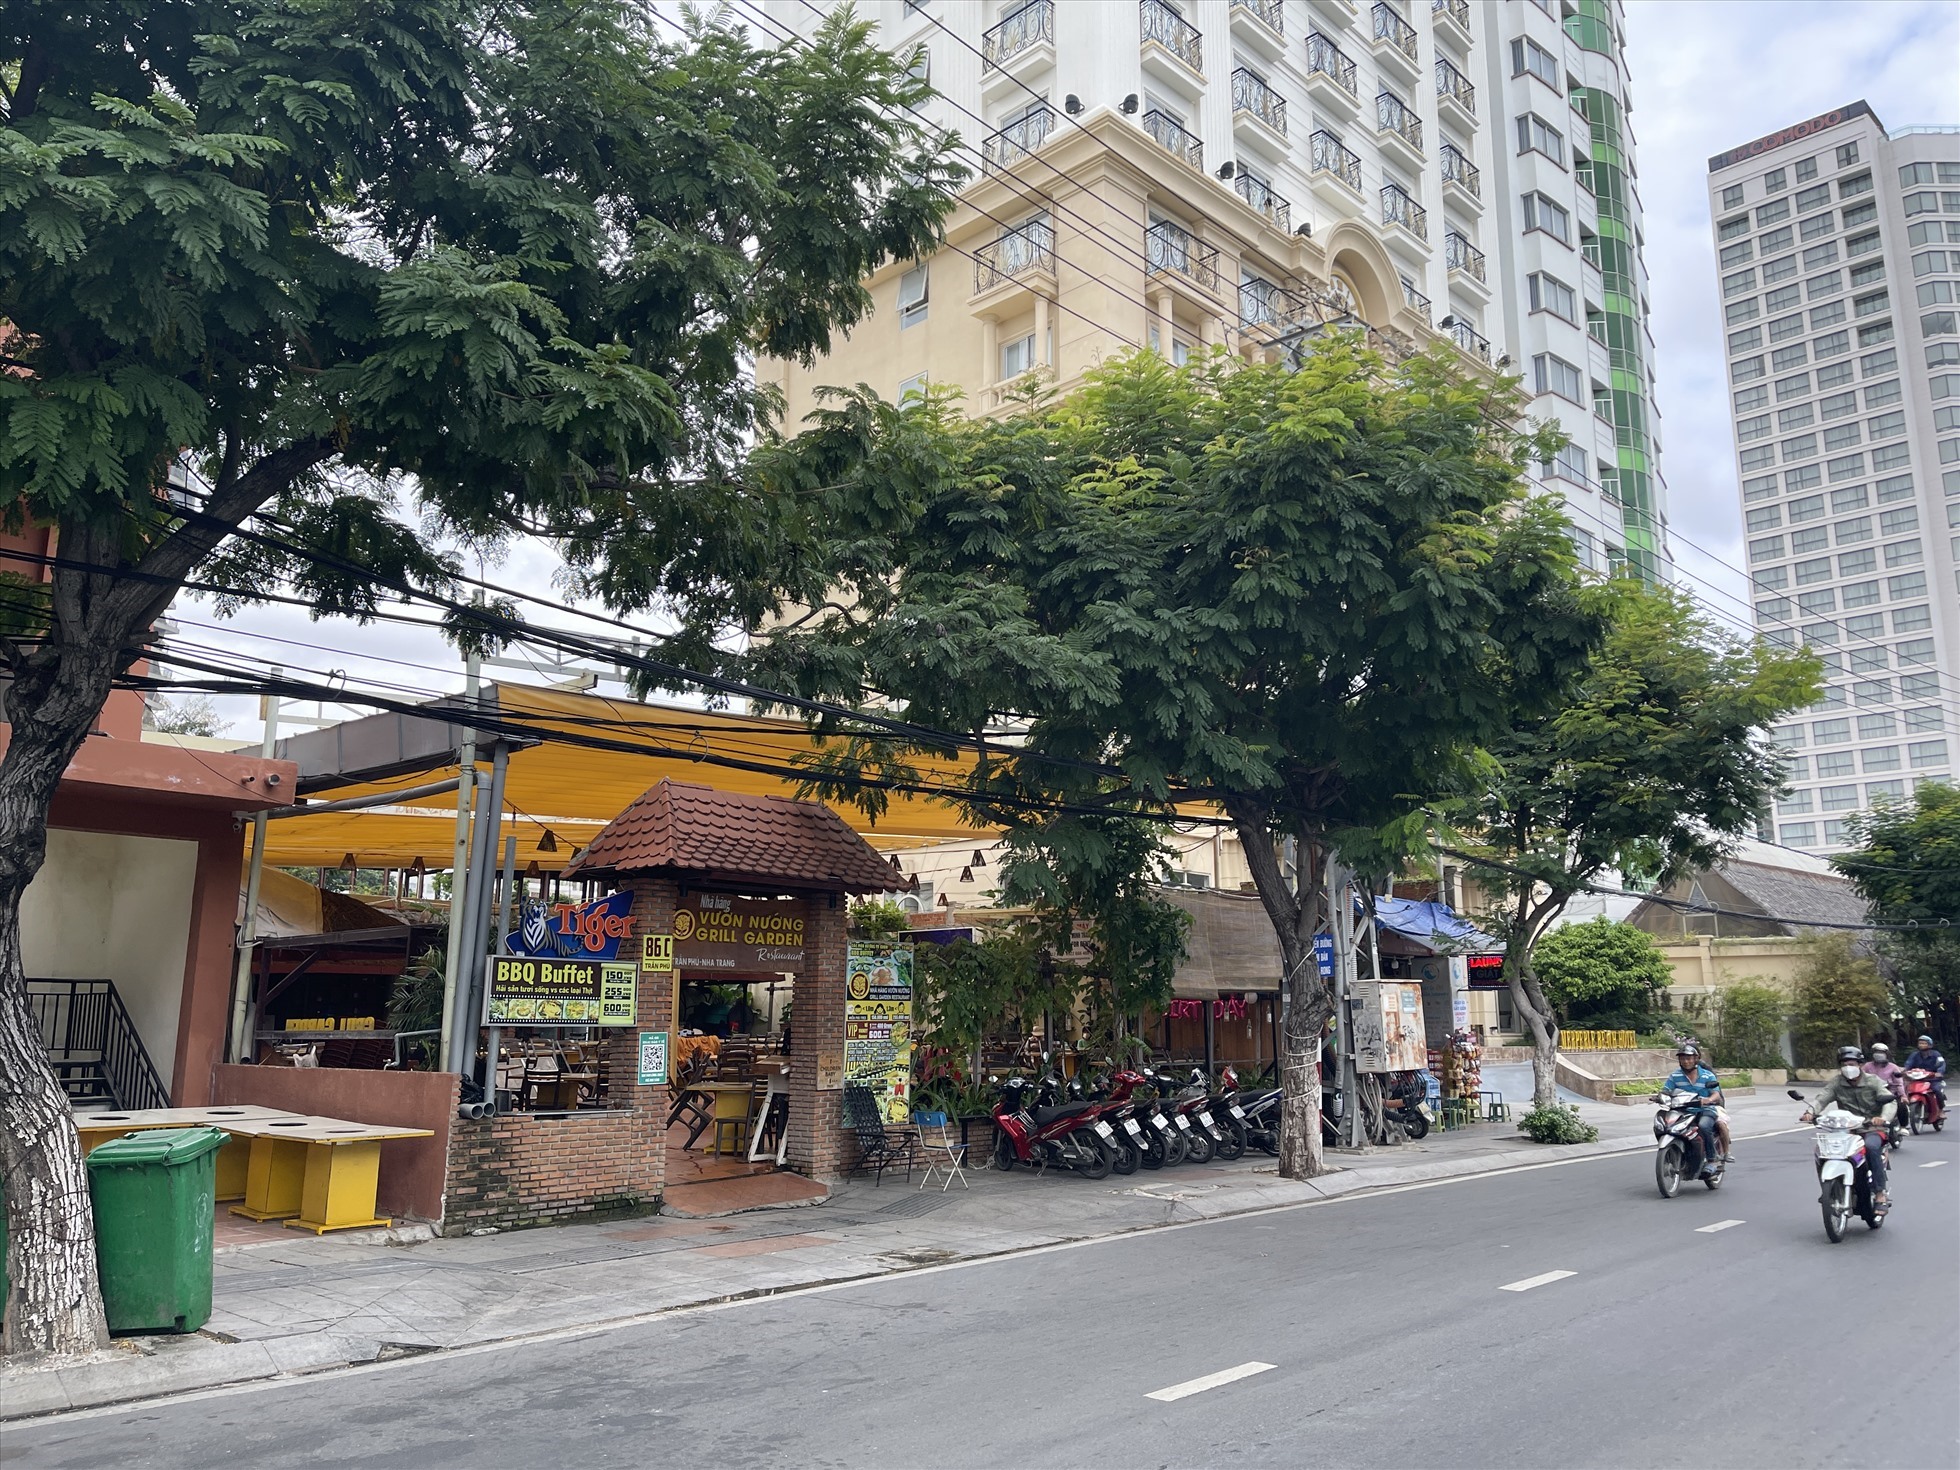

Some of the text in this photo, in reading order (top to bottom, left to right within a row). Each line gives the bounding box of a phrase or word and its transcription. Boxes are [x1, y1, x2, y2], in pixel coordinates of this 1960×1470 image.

[1749, 111, 1841, 155] COMODO
[553, 902, 637, 952] Tiger
[749, 912, 804, 931] NƯỚNG
[696, 928, 803, 946] GRILL GARDEN
[646, 937, 661, 957] 86
[756, 947, 805, 961] Restaurant
[645, 961, 658, 969] TRẦN
[716, 959, 735, 967] TRANG
[497, 961, 593, 985] BBQ Buffet
[606, 971, 622, 979] 150
[535, 986, 549, 994] sống
[571, 987, 581, 995] loại
[582, 987, 593, 995] Thịt
[605, 987, 622, 995] 255
[604, 1003, 621, 1011] 600
[848, 1024, 858, 1037] VIP
